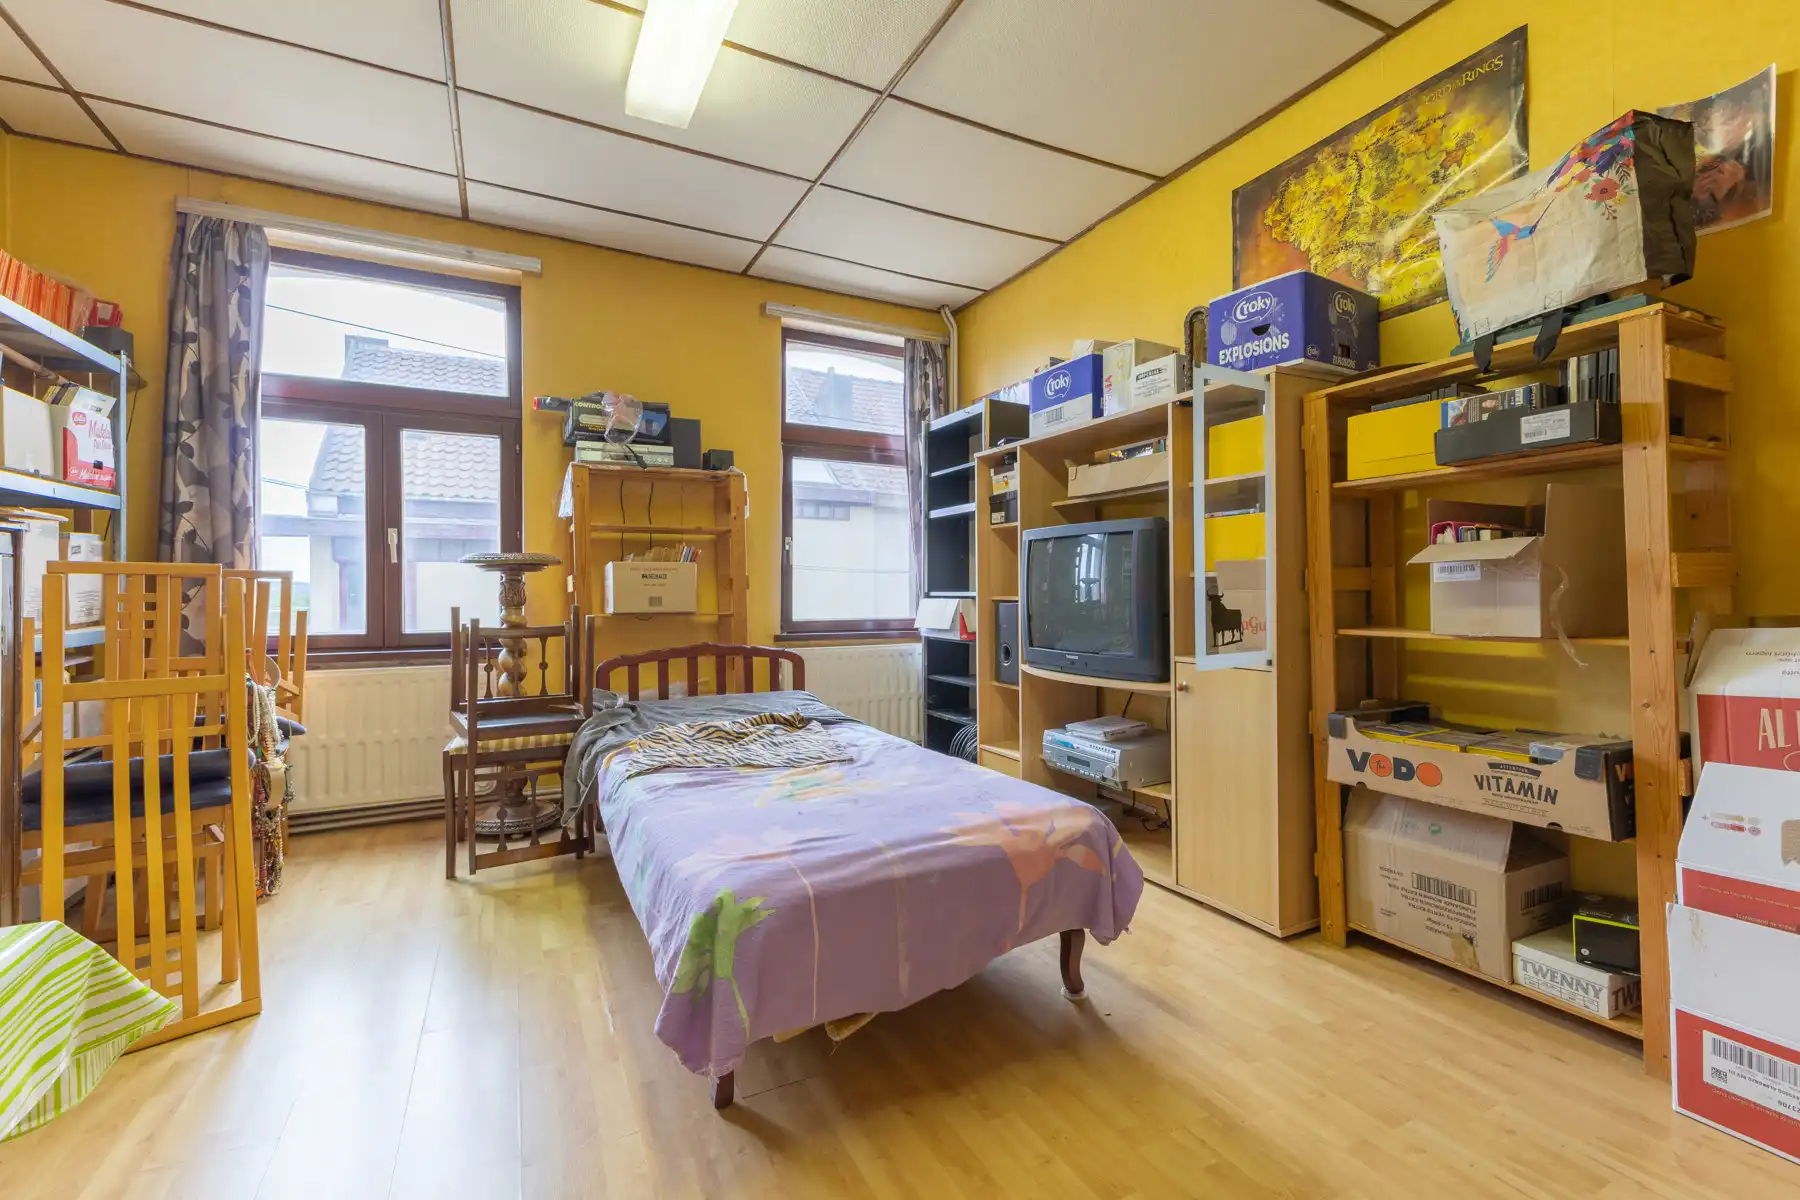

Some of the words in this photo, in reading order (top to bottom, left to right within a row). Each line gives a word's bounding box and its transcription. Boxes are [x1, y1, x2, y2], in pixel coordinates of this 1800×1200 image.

[1461, 54, 1503, 87] RINGS
[1235, 296, 1272, 320] Croky
[1334, 294, 1356, 314] Croky
[1219, 332, 1290, 366] EXPLOSIONS
[1046, 373, 1070, 396] Croky
[1758, 708, 1792, 751] AL
[1473, 774, 1559, 806] VITAMIN
[1520, 958, 1604, 1000] TWENNY
